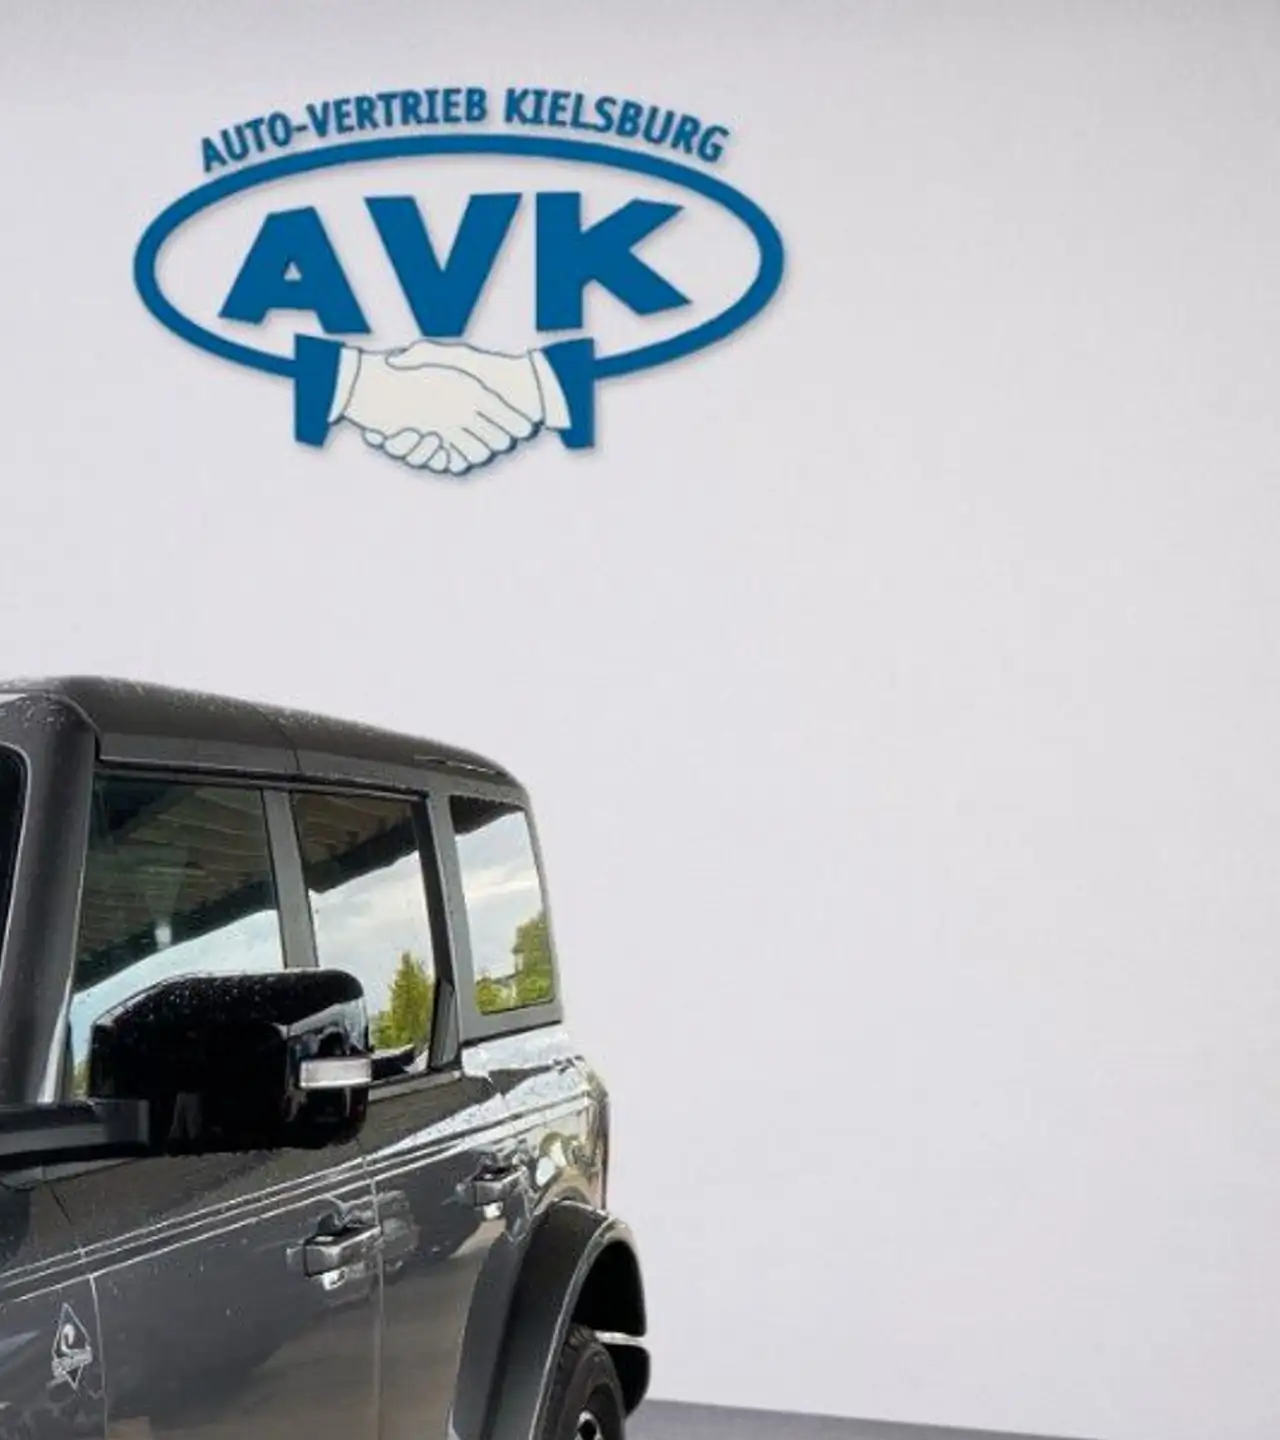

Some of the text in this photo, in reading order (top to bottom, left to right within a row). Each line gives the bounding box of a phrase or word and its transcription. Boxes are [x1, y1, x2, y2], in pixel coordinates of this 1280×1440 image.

[200, 87, 730, 172] AUTO-VERTRIEB KIELSBURG
[218, 191, 692, 337] AVK
